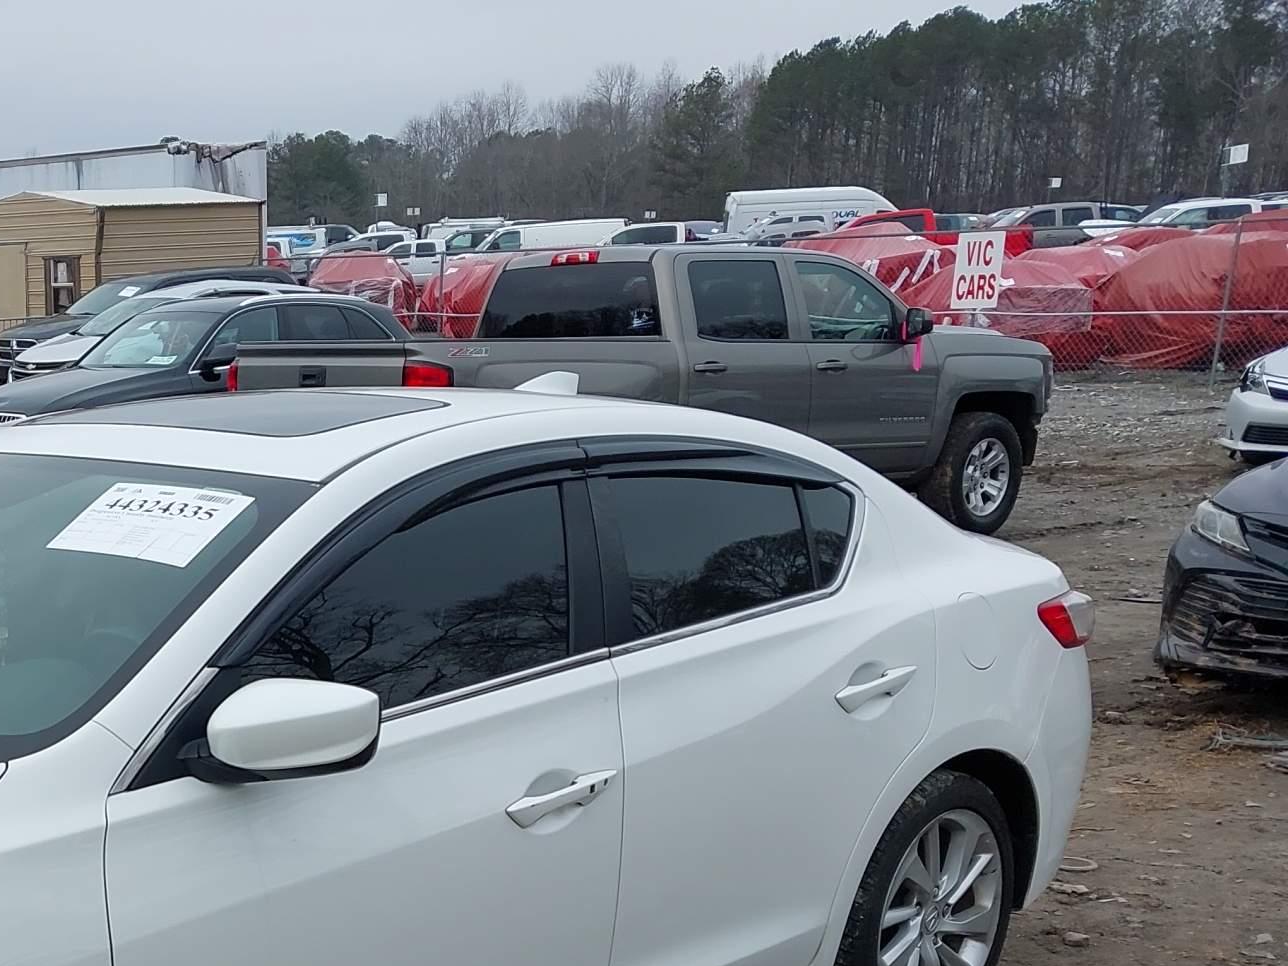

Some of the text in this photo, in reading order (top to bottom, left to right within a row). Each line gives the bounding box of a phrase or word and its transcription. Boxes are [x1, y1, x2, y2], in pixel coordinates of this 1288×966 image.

[967, 239, 994, 267] VIC
[955, 273, 997, 301] CARS
[104, 497, 219, 521] 44324335
